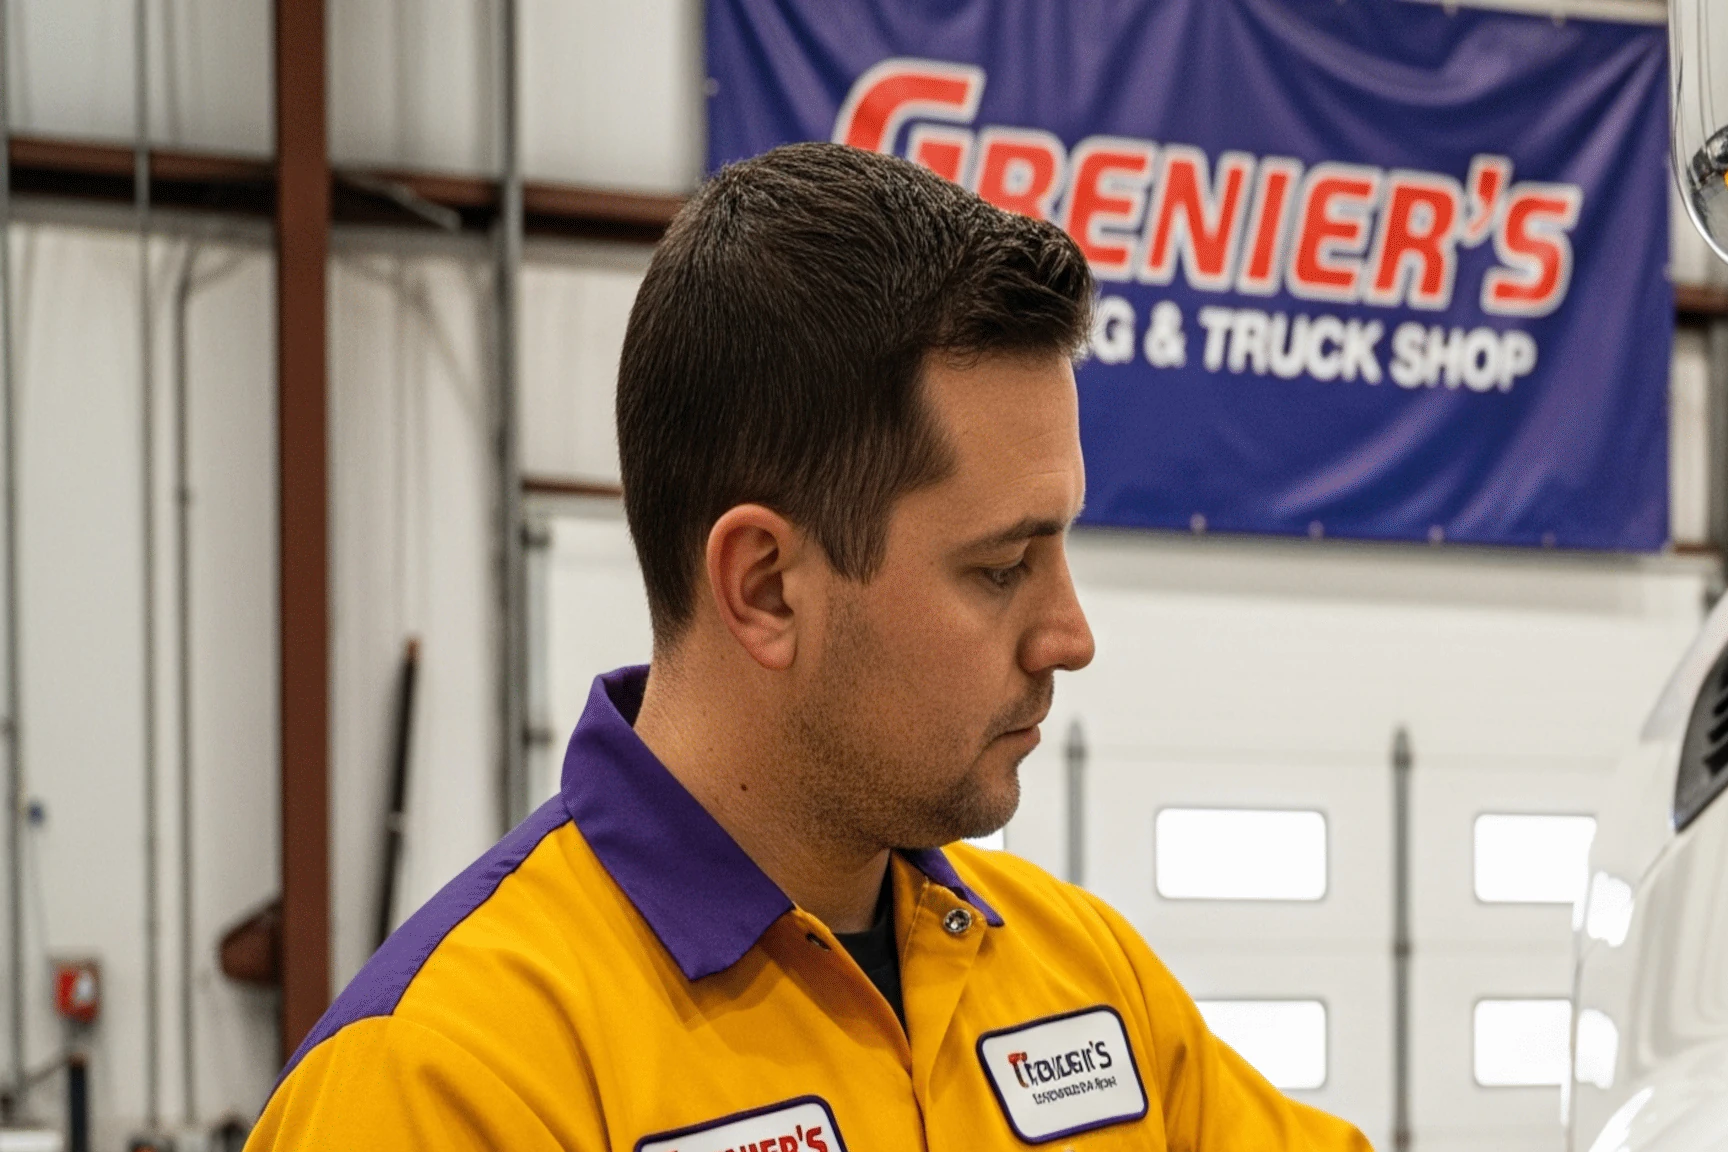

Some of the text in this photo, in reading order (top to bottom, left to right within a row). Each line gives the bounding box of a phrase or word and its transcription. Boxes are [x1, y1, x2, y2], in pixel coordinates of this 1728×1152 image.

[1143, 301, 1188, 369] &
[1197, 306, 1385, 382] TRUCK
[1390, 322, 1538, 392] SHOP
